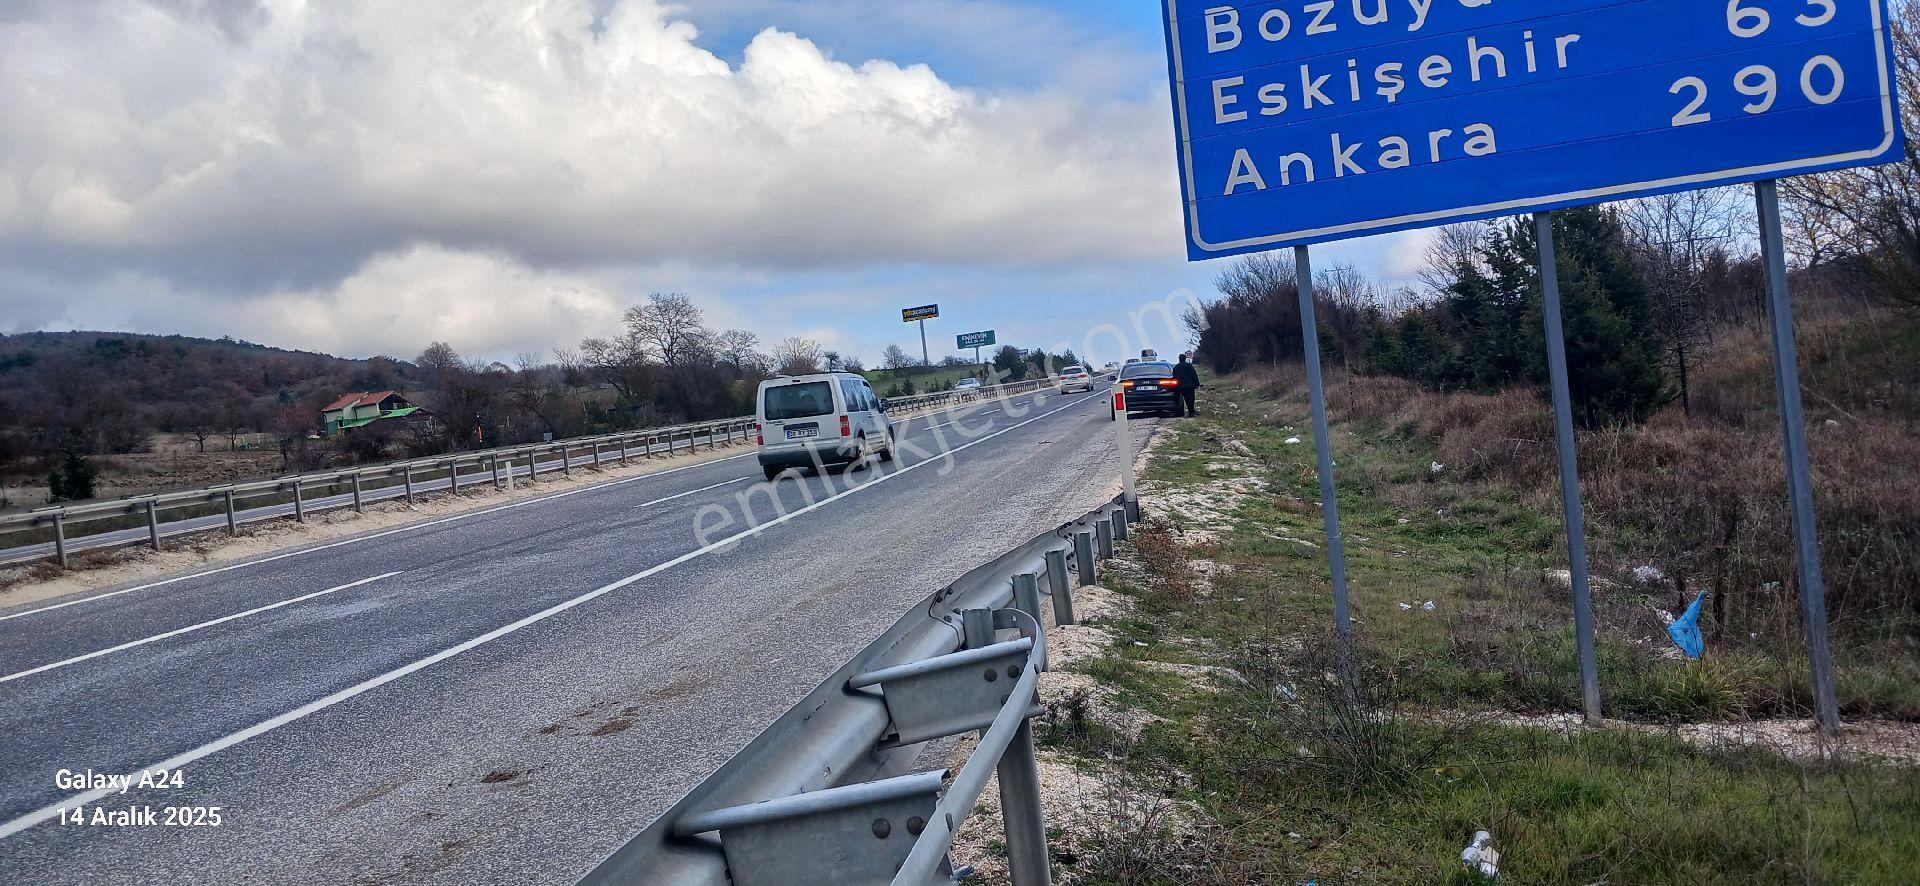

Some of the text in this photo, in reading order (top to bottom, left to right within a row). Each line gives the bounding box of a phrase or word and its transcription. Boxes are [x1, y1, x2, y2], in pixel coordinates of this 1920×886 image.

[1212, 30, 1581, 125] Eskişehir
[1223, 54, 1845, 196] Ankara 290
